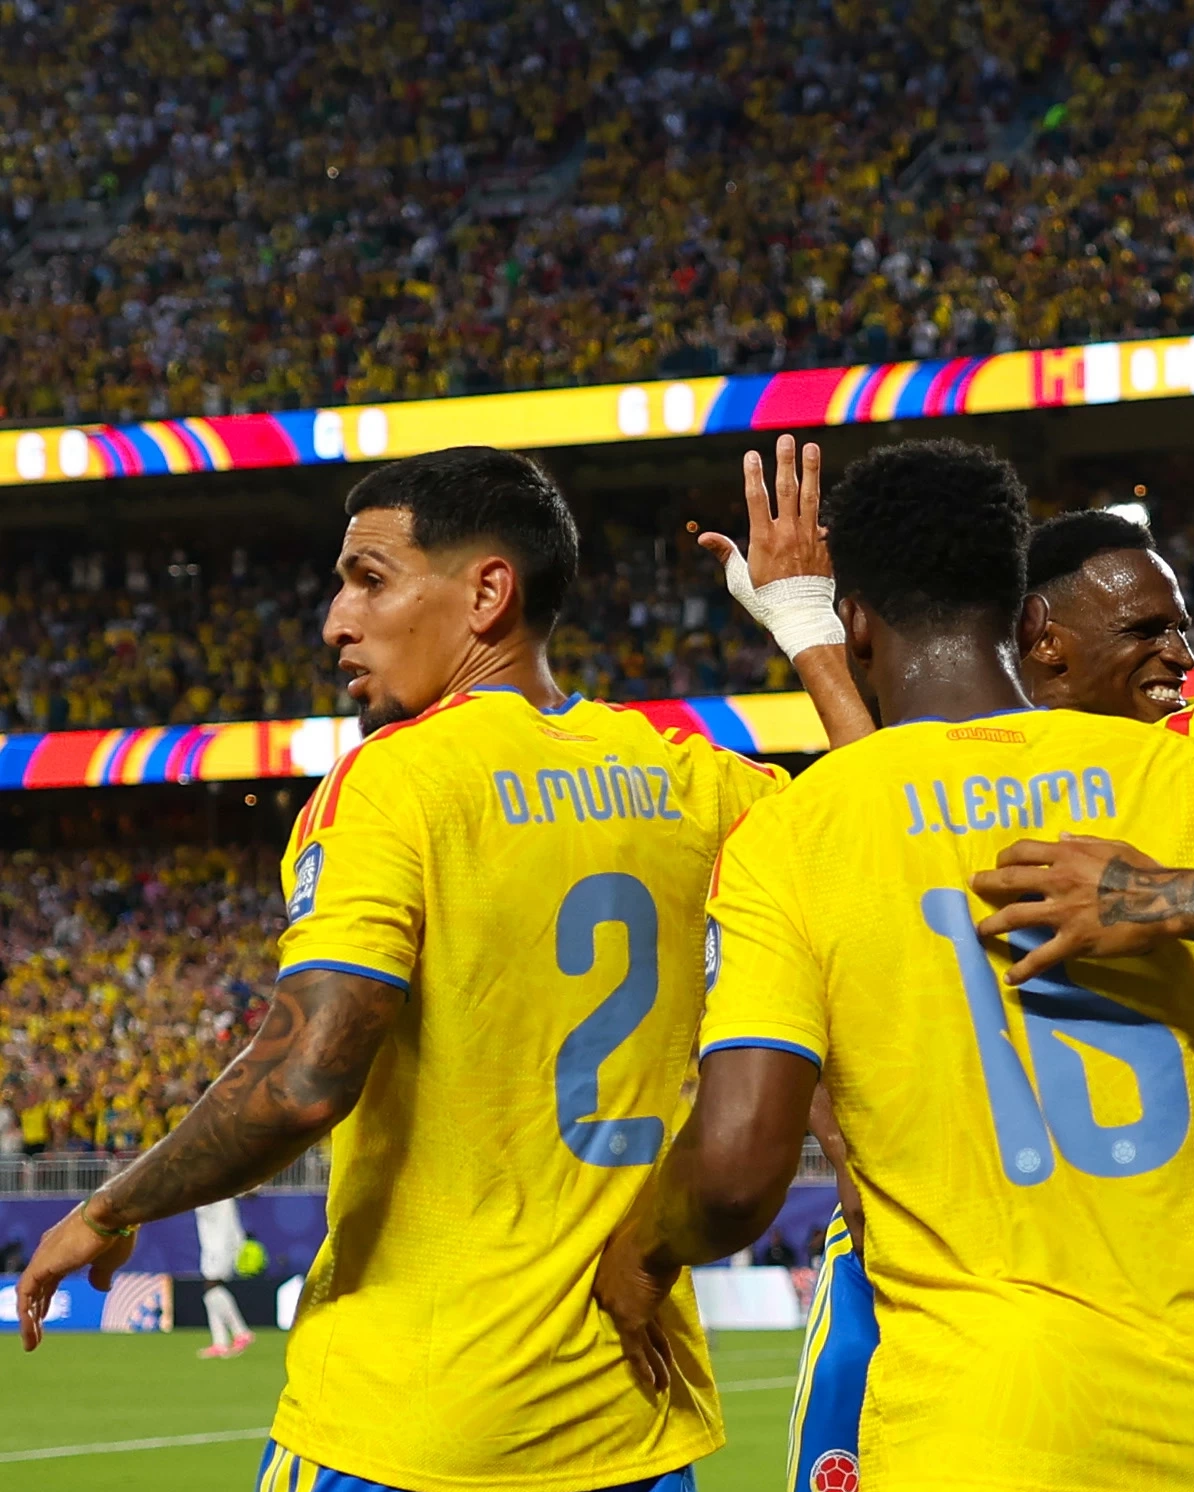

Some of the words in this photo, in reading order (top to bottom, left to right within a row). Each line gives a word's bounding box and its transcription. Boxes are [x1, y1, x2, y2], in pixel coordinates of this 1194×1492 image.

[947, 727, 1026, 743] COLOMBIA
[493, 754, 682, 824] D.MUÑOZ
[904, 767, 1116, 835] J.LERMA
[555, 872, 664, 1167] 2
[921, 888, 1190, 1186] 16
